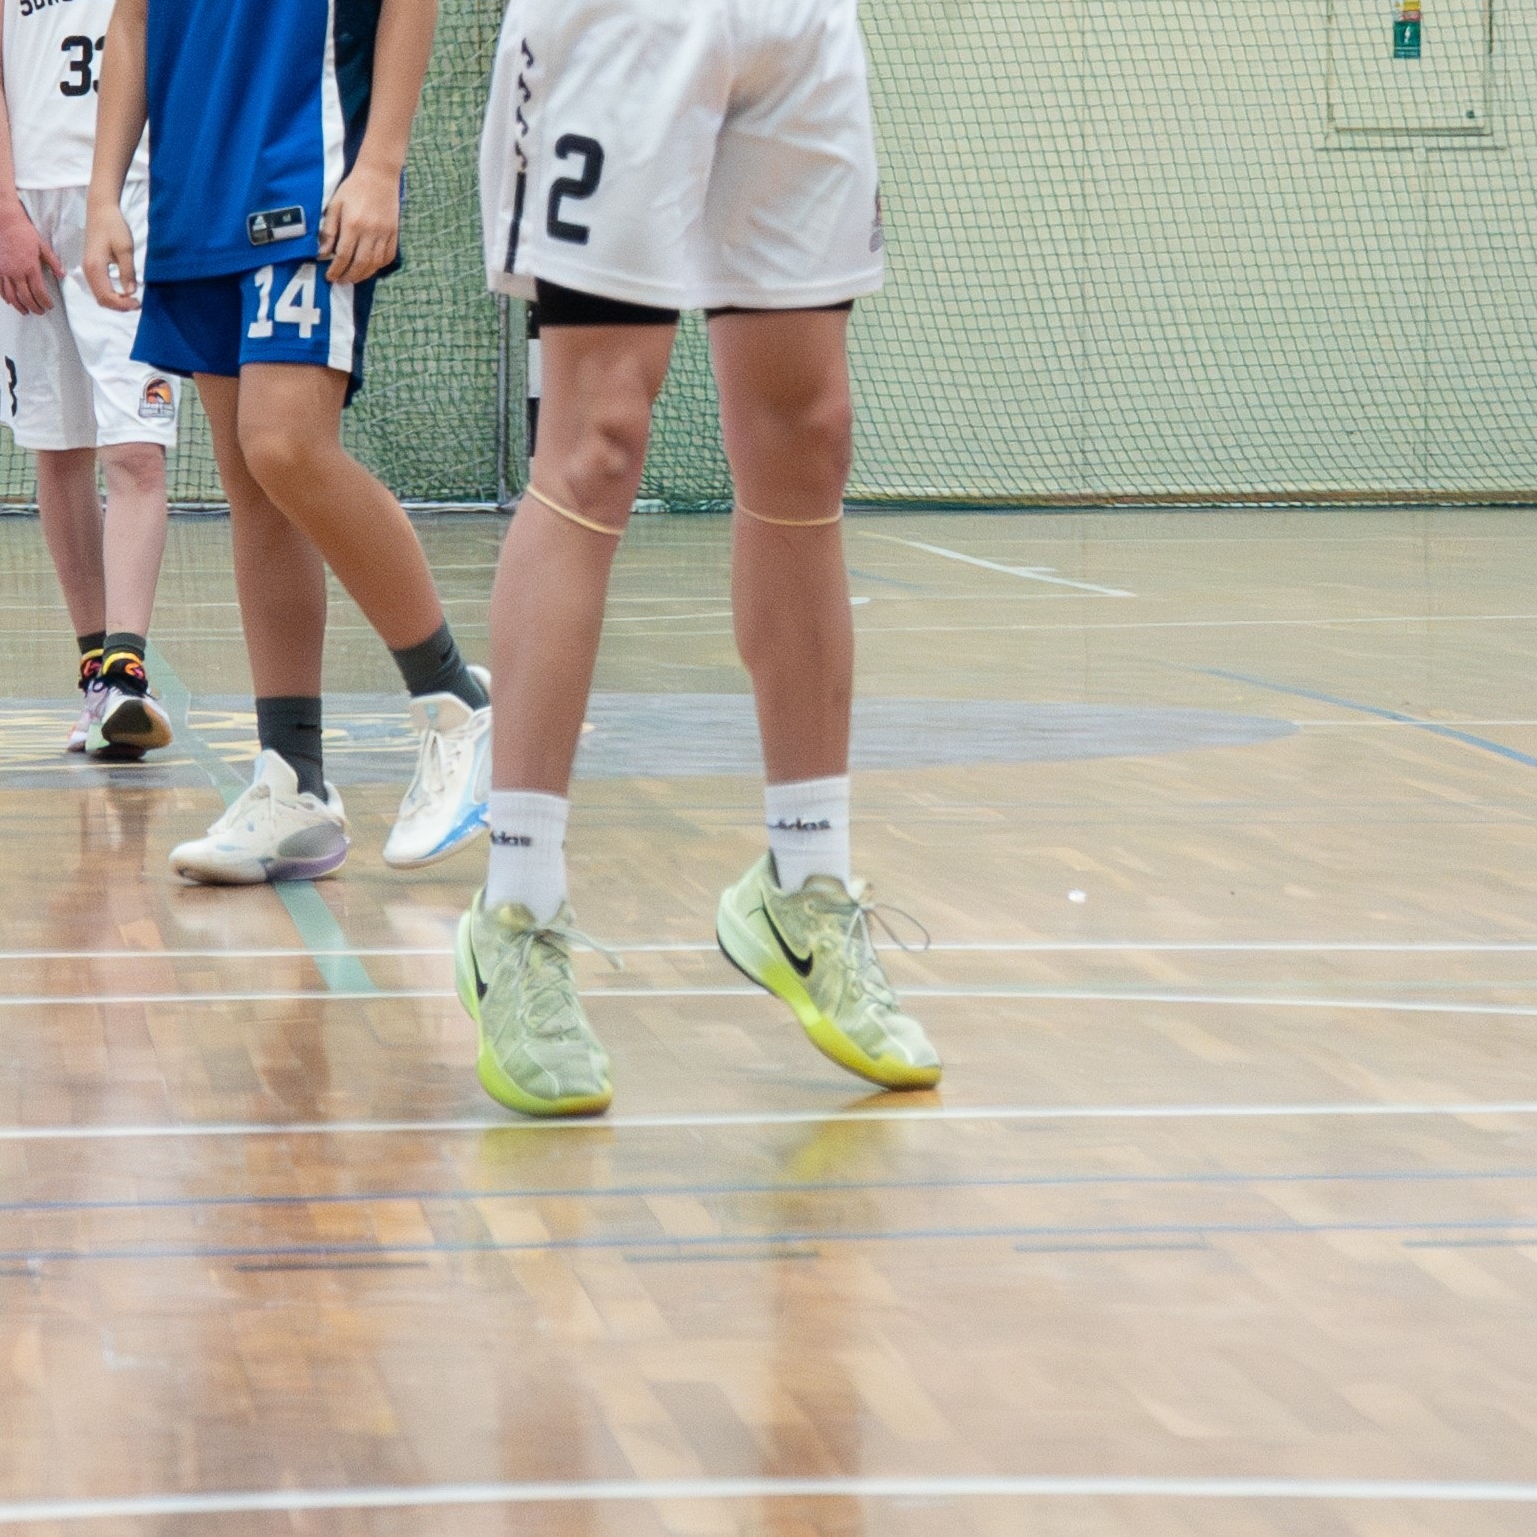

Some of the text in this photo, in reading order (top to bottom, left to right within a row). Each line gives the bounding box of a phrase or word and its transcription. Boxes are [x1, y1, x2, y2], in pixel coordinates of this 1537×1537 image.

[60, 35, 105, 97] 3
[547, 133, 605, 245] 2
[247, 263, 321, 339] 14
[767, 816, 831, 832] idas
